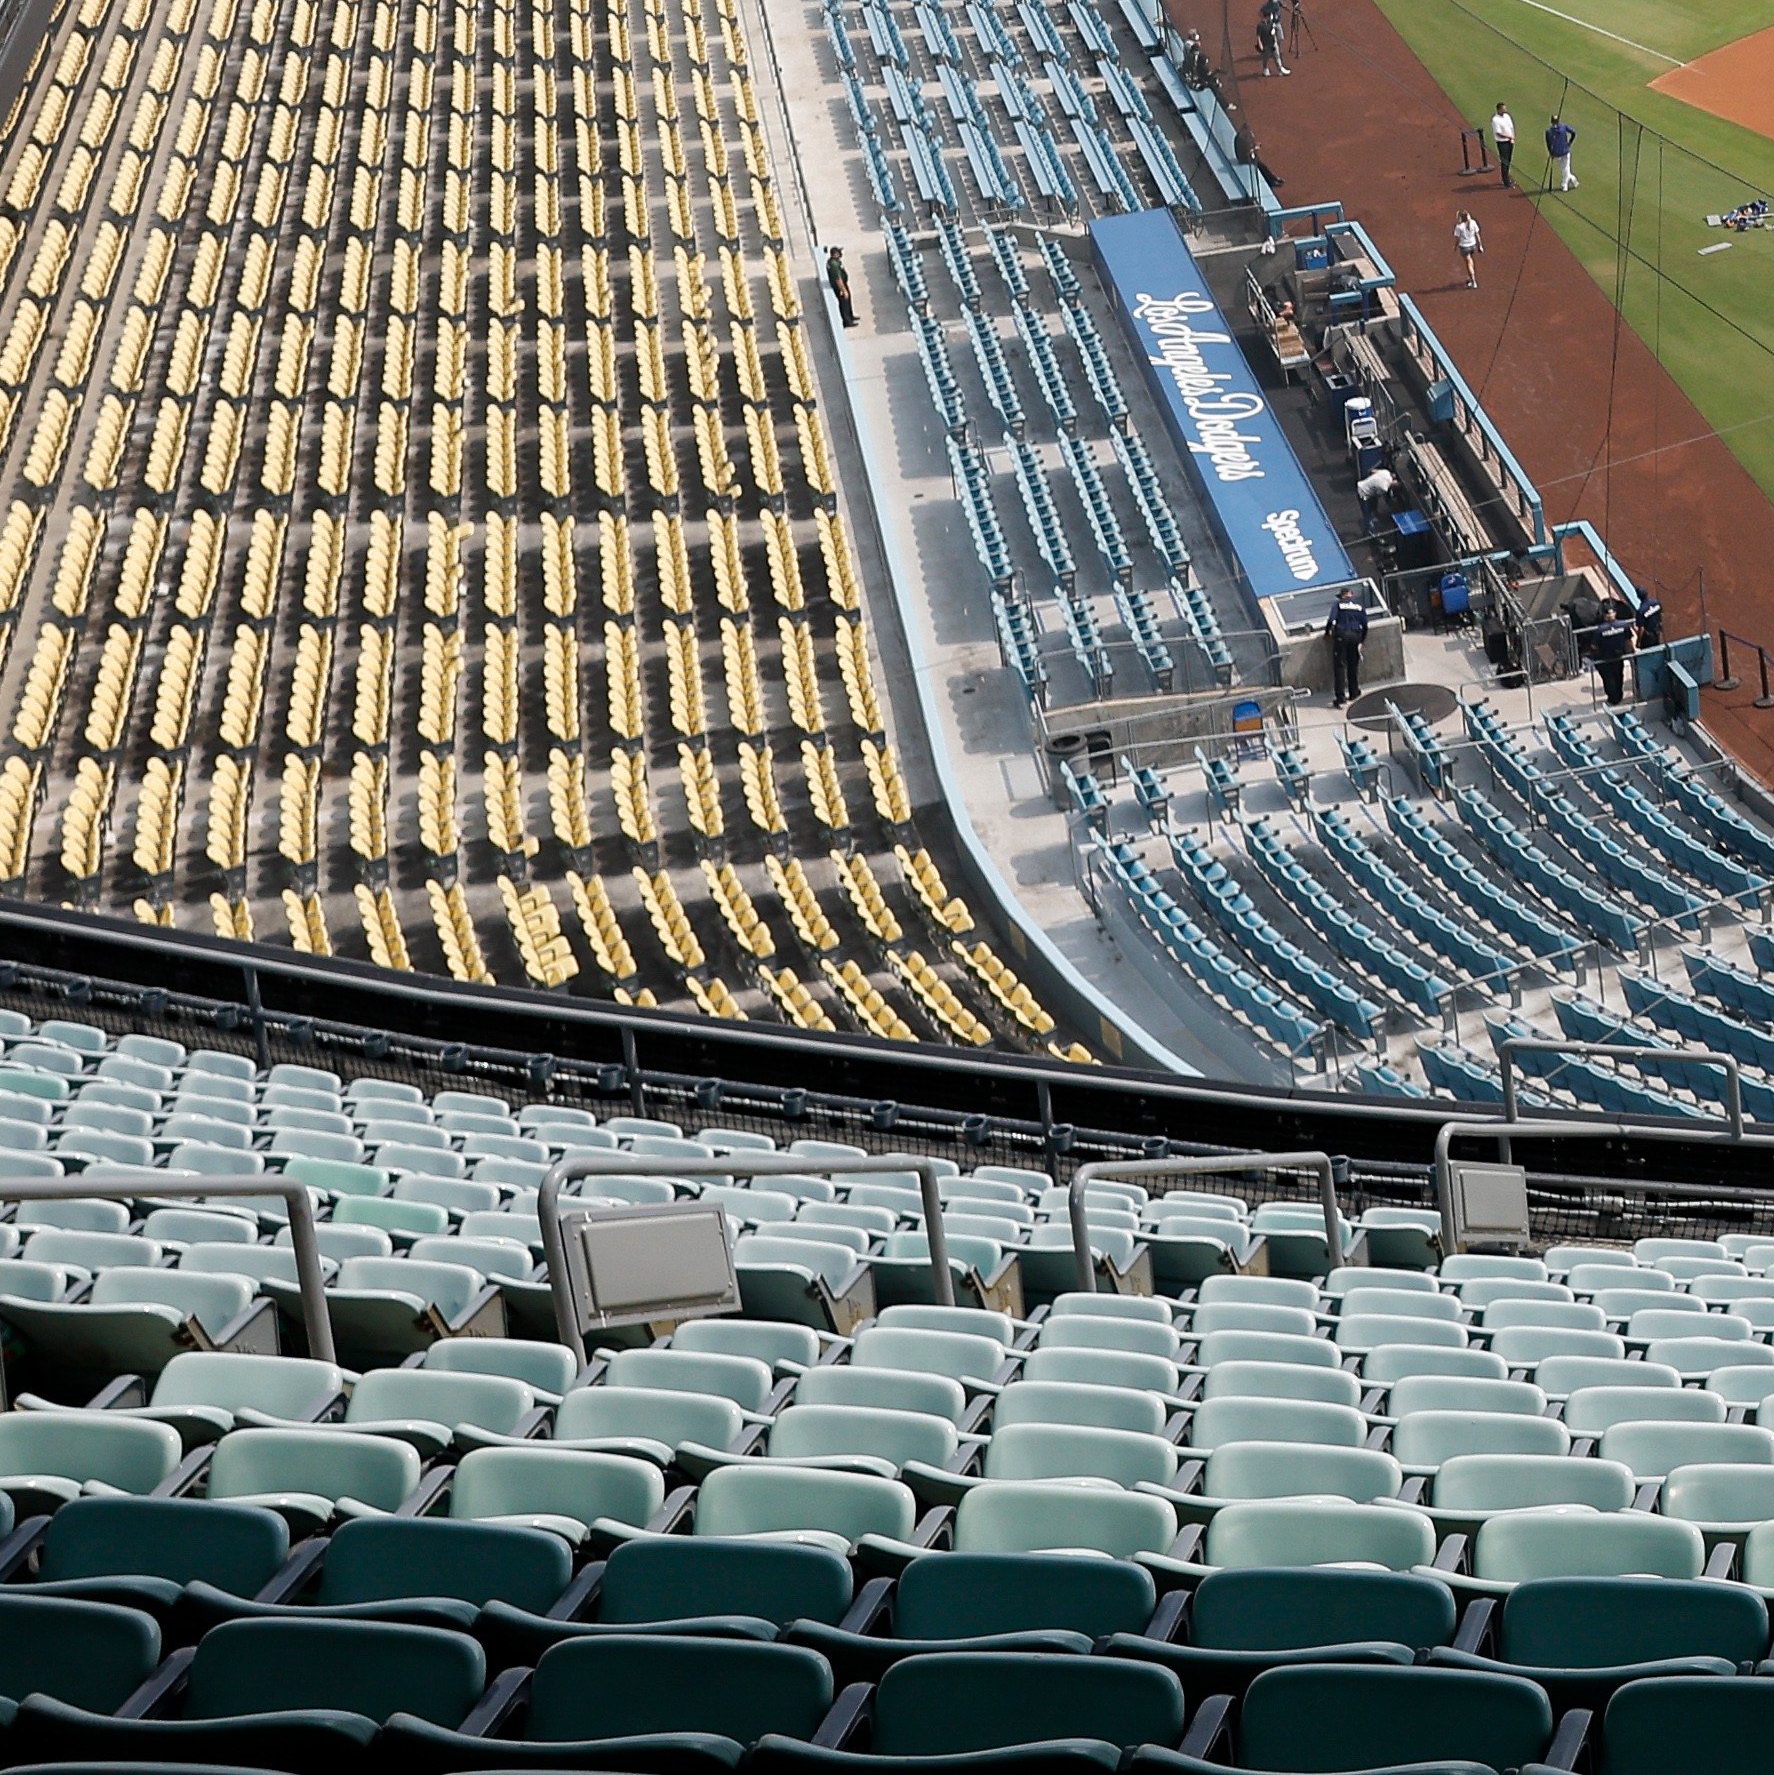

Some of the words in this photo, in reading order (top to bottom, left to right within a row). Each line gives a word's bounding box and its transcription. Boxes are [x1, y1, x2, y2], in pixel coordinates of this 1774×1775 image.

[1133, 291, 1214, 324] Los
[1148, 323, 1232, 396] Angeles
[1184, 392, 1266, 482] Dodgers
[1261, 509, 1319, 580] Spectrum
